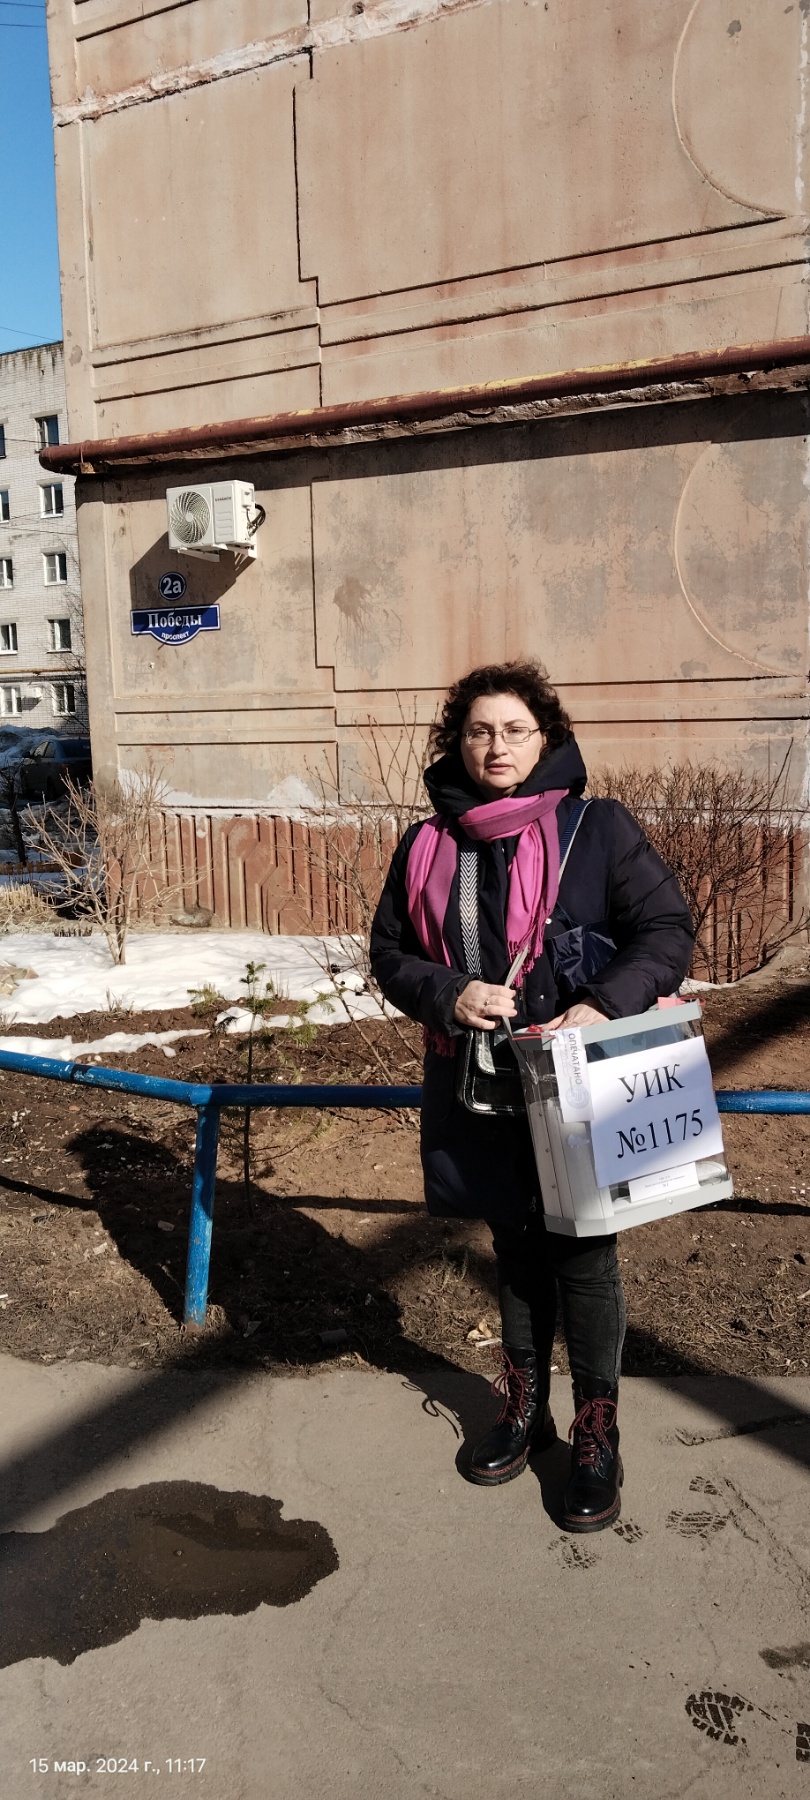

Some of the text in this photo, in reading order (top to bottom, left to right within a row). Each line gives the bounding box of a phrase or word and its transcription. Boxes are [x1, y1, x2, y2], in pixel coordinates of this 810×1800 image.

[162, 577, 182, 595] 2а
[148, 612, 203, 629] Победы
[161, 630, 190, 641] проспект
[568, 1033, 583, 1085] ОПЕЧАТАНО
[618, 1063, 685, 1103] УИК
[615, 1108, 704, 1159] №1175
